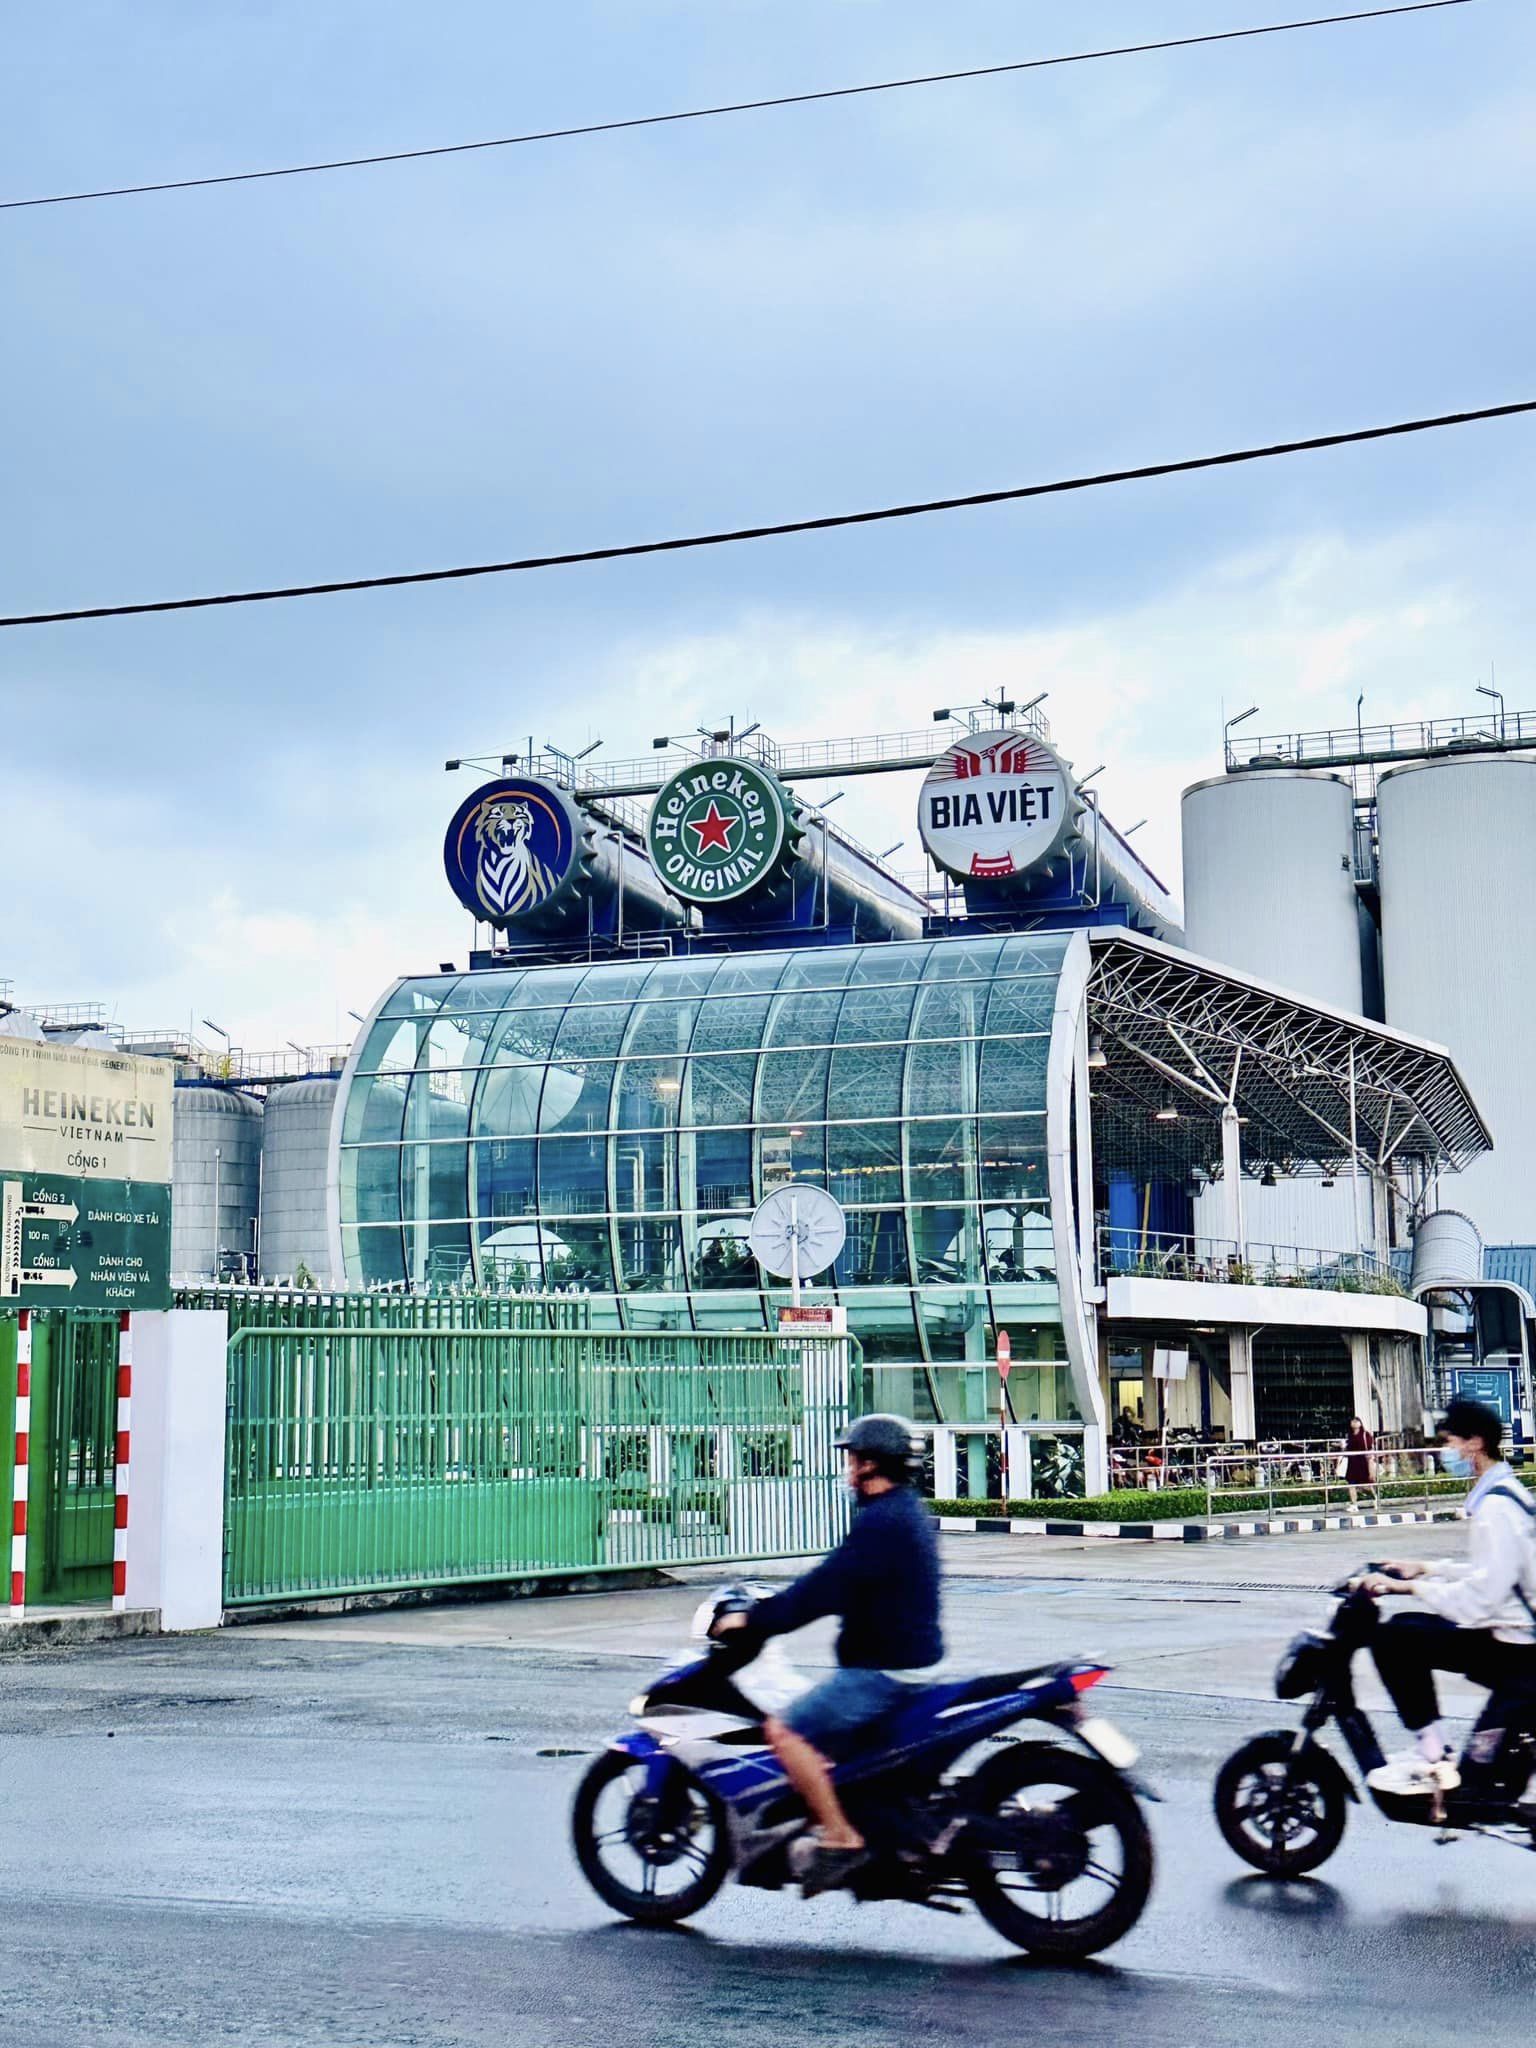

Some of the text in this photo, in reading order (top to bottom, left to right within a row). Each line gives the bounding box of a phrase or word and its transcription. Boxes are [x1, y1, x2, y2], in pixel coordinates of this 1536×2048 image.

[656, 770, 766, 839] Heineken
[931, 783, 1054, 829] BIA VIỆT
[666, 848, 764, 892] ORIGINAL
[24, 1088, 154, 1128] HEINEKEN
[60, 1126, 123, 1142] VIETNAM
[60, 1193, 65, 1203] 3
[114, 1212, 131, 1223] CHO
[134, 1214, 144, 1223] XE
[28, 1230, 40, 1240] 100
[125, 1257, 143, 1267] CHO
[106, 1285, 135, 1297] KHÁCH
